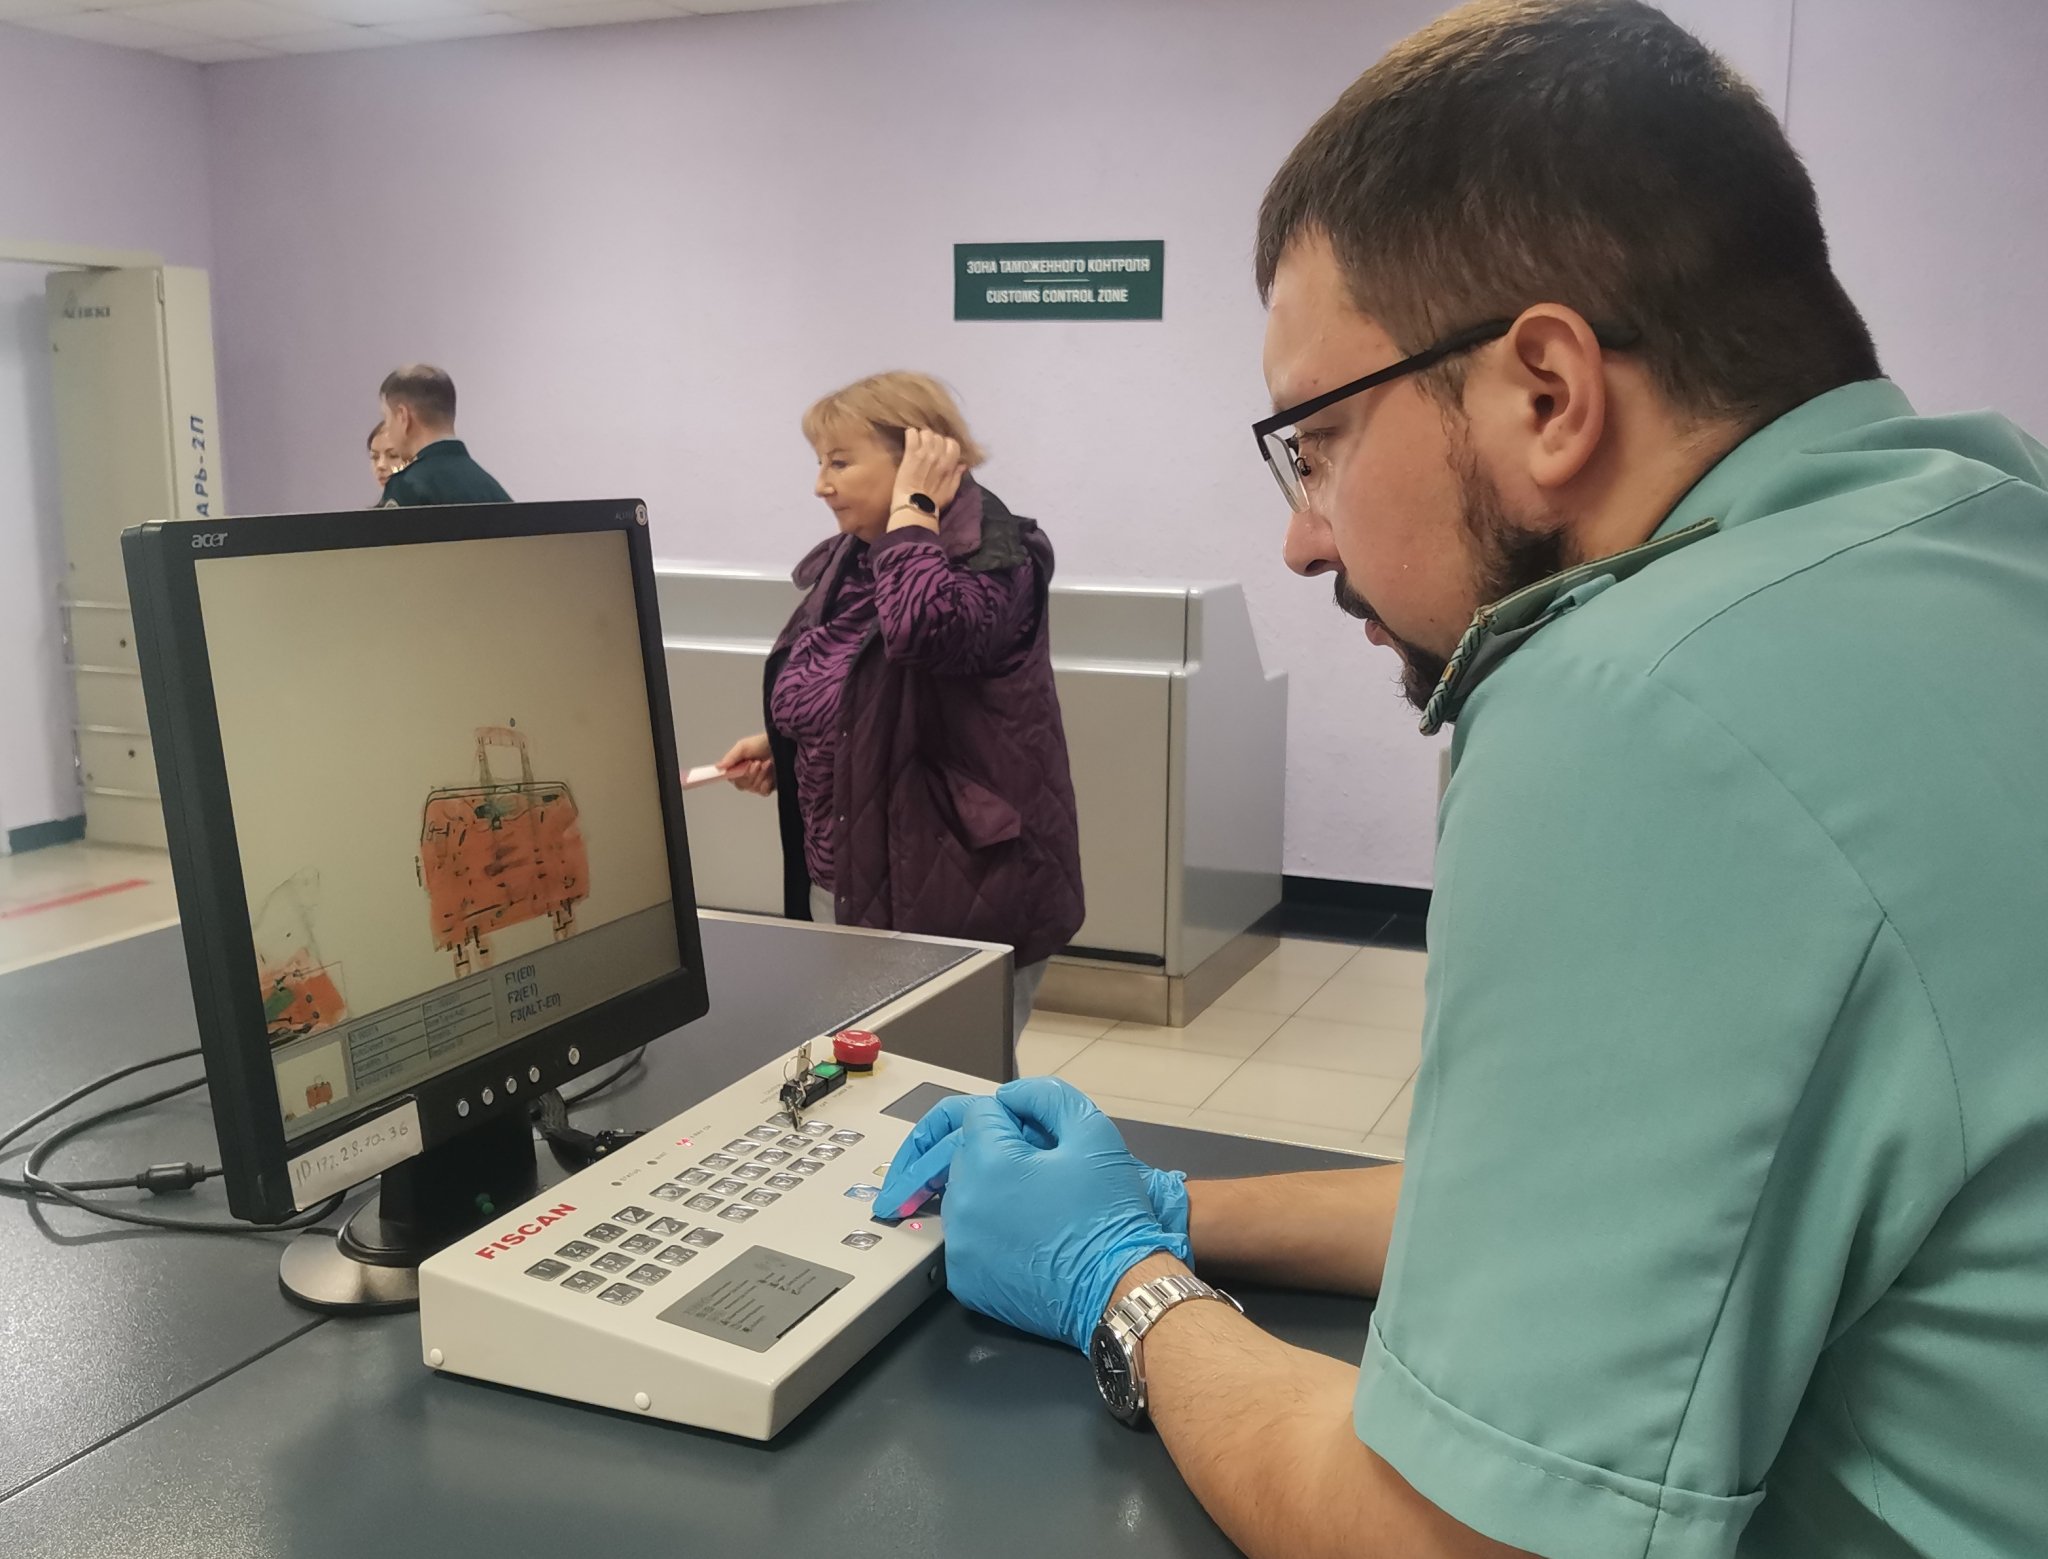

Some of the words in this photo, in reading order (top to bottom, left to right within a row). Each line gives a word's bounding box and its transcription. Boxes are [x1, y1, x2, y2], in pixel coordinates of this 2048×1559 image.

[966, 260, 997, 274] ЗОНА
[999, 259, 1086, 274] ТАМОЖЕННОГО
[1087, 257, 1151, 273] КОНТРОЛЯ
[985, 288, 1040, 304] CUSTOMS
[1042, 288, 1096, 303] CONTROL
[1097, 288, 1129, 303] ZONE
[191, 532, 228, 549] acer
[474, 1203, 578, 1260] FISCAN
